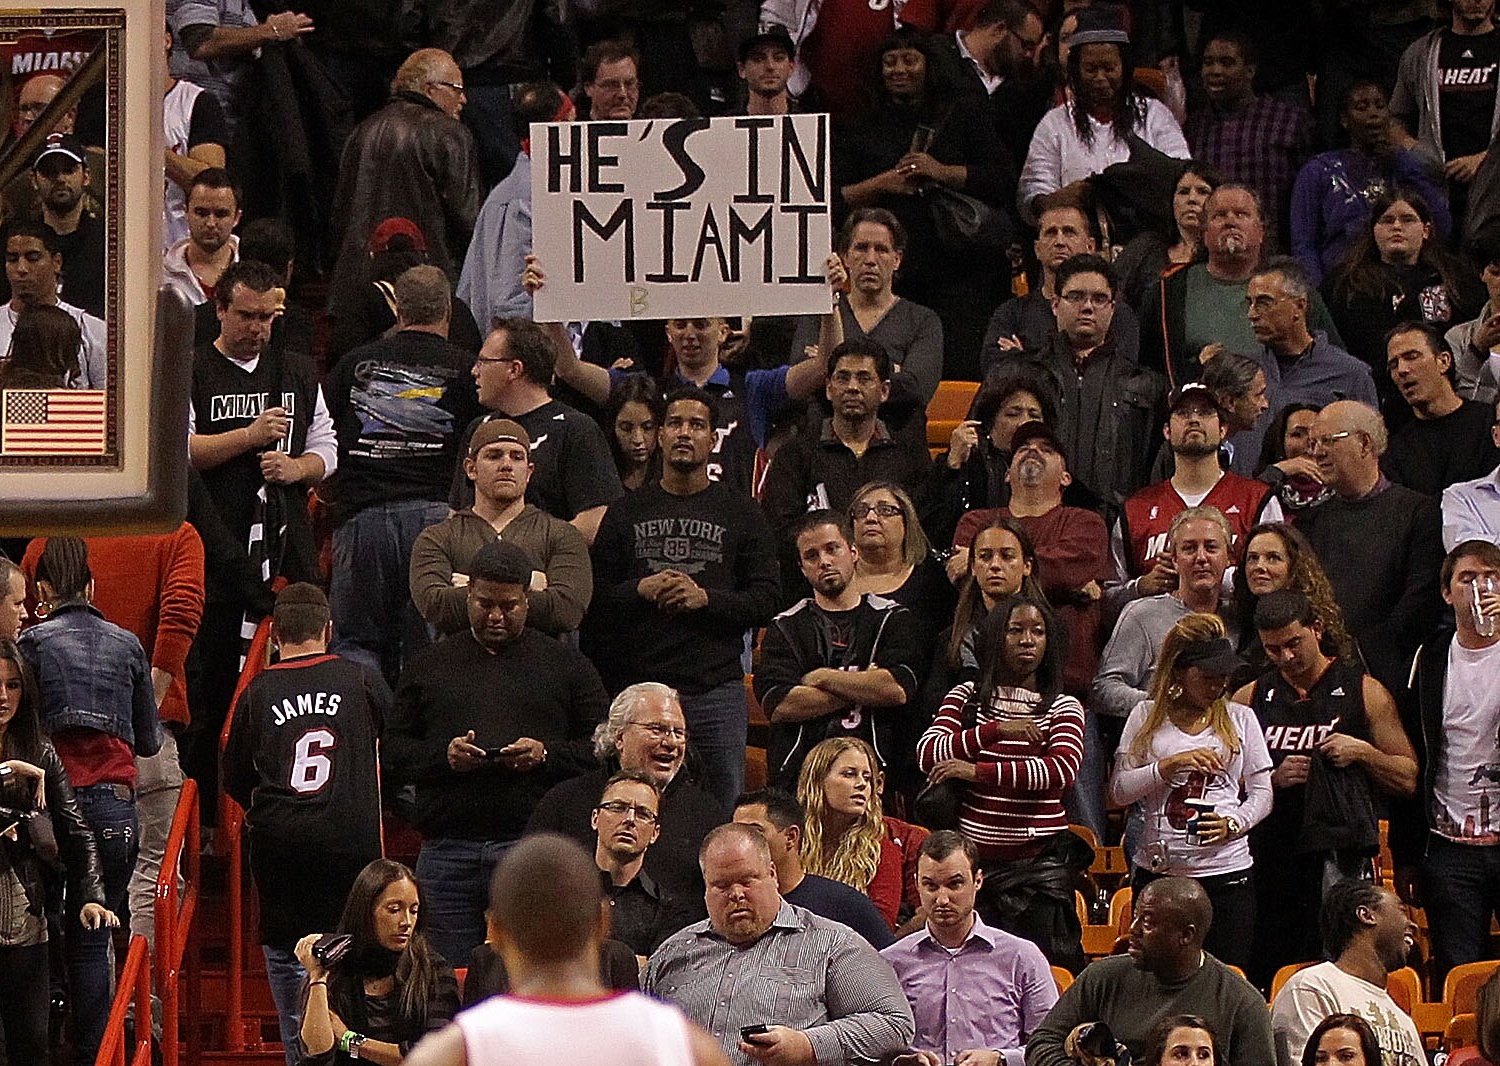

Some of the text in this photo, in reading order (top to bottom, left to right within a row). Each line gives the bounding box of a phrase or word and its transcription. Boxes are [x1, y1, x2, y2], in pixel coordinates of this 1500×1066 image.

[12, 51, 90, 75] MIAM
[1444, 62, 1498, 85] HEAT
[548, 115, 827, 204] HE'S IN
[572, 198, 828, 284] MIAMI
[633, 519, 727, 544] NEW YORK
[271, 691, 342, 727] JAMES
[1265, 716, 1343, 751] HEAT
[289, 728, 337, 795] 6
